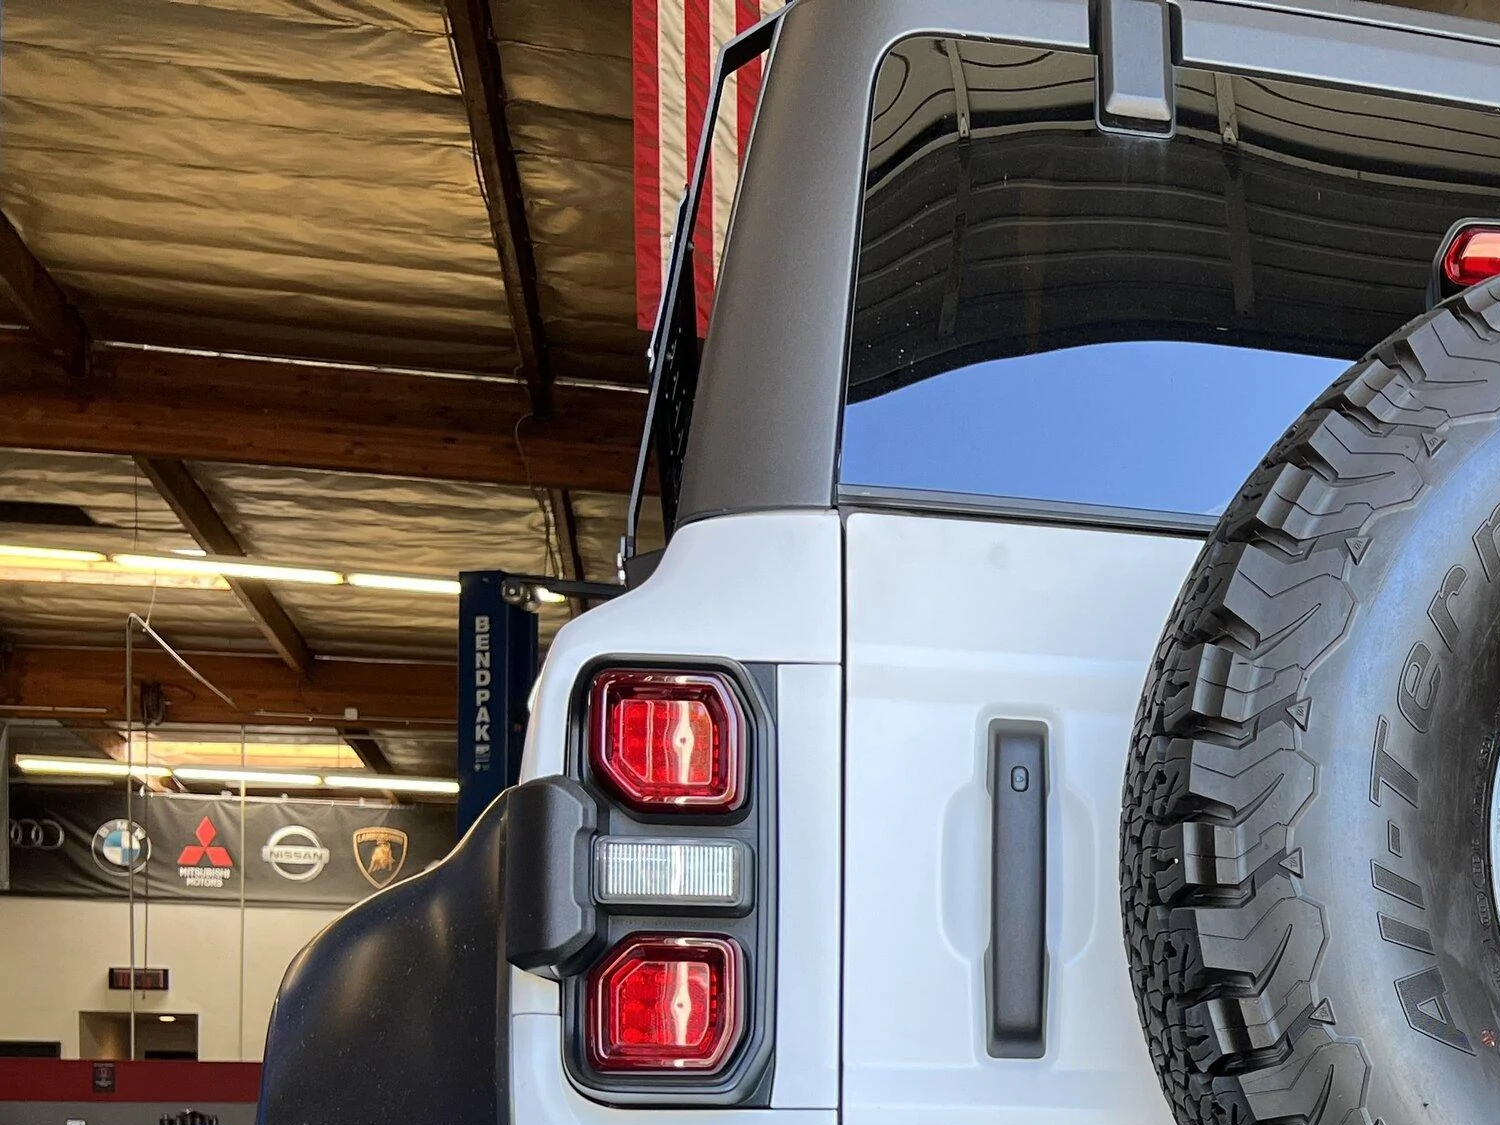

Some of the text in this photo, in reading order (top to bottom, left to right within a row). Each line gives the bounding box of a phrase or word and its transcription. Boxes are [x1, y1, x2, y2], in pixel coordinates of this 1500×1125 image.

[475, 615, 491, 742] BENDPAK
[269, 851, 324, 861] NISSAN
[179, 867, 231, 879] MITSUBISHI
[186, 878, 224, 888] MOTORS
